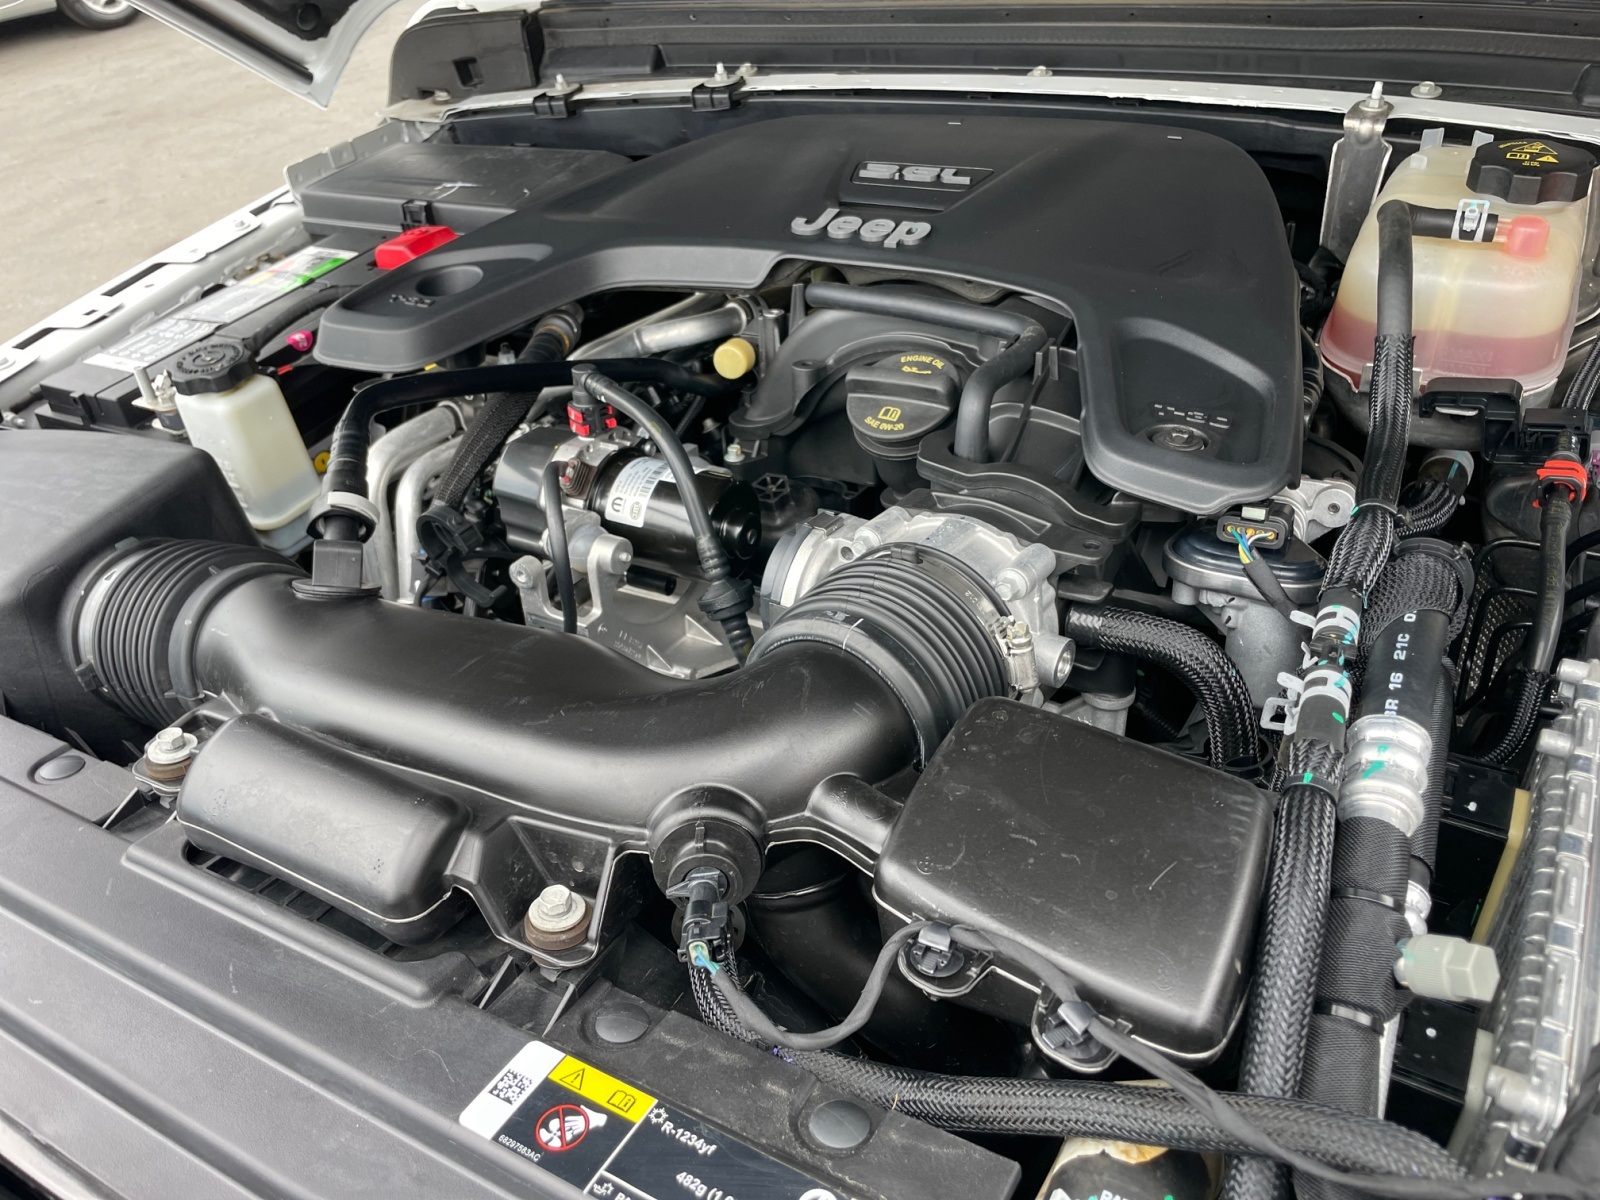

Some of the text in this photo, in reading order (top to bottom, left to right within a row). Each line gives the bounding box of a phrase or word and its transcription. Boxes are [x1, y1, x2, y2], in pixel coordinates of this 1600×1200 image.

[791, 208, 932, 248] Jeep
[900, 355, 945, 369] ENGINE OIL
[864, 416, 905, 431] SAE 0W-20
[1393, 633, 1410, 660] 21C
[1388, 672, 1404, 690] 16
[498, 1134, 541, 1162] 68297583AC
[660, 1120, 718, 1156] R-1234yf
[675, 1171, 708, 1198] 482g
